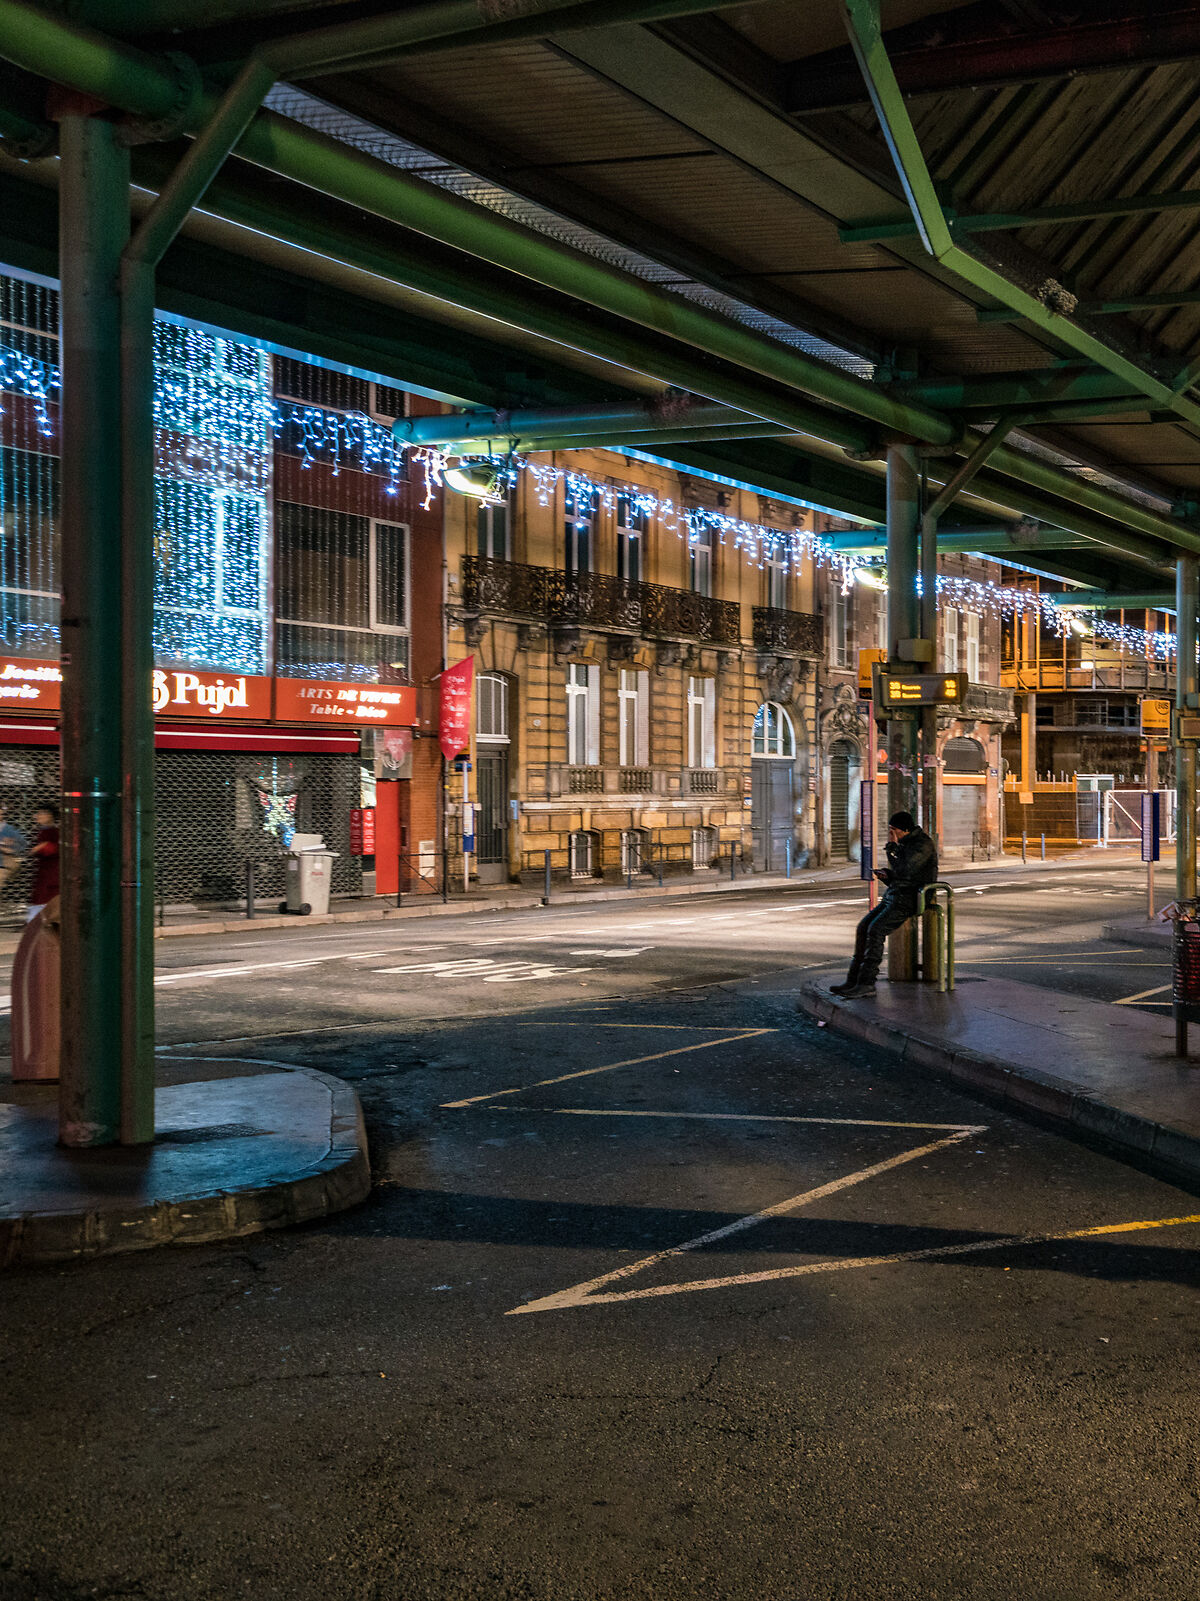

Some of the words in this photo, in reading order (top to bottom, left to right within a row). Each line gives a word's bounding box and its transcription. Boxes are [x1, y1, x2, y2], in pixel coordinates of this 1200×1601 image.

[171, 672, 249, 714] Pujol
[296, 687, 334, 699] ARTS
[337, 689, 358, 701] DE
[309, 703, 344, 716] Table
[370, 958, 606, 982] BUS
